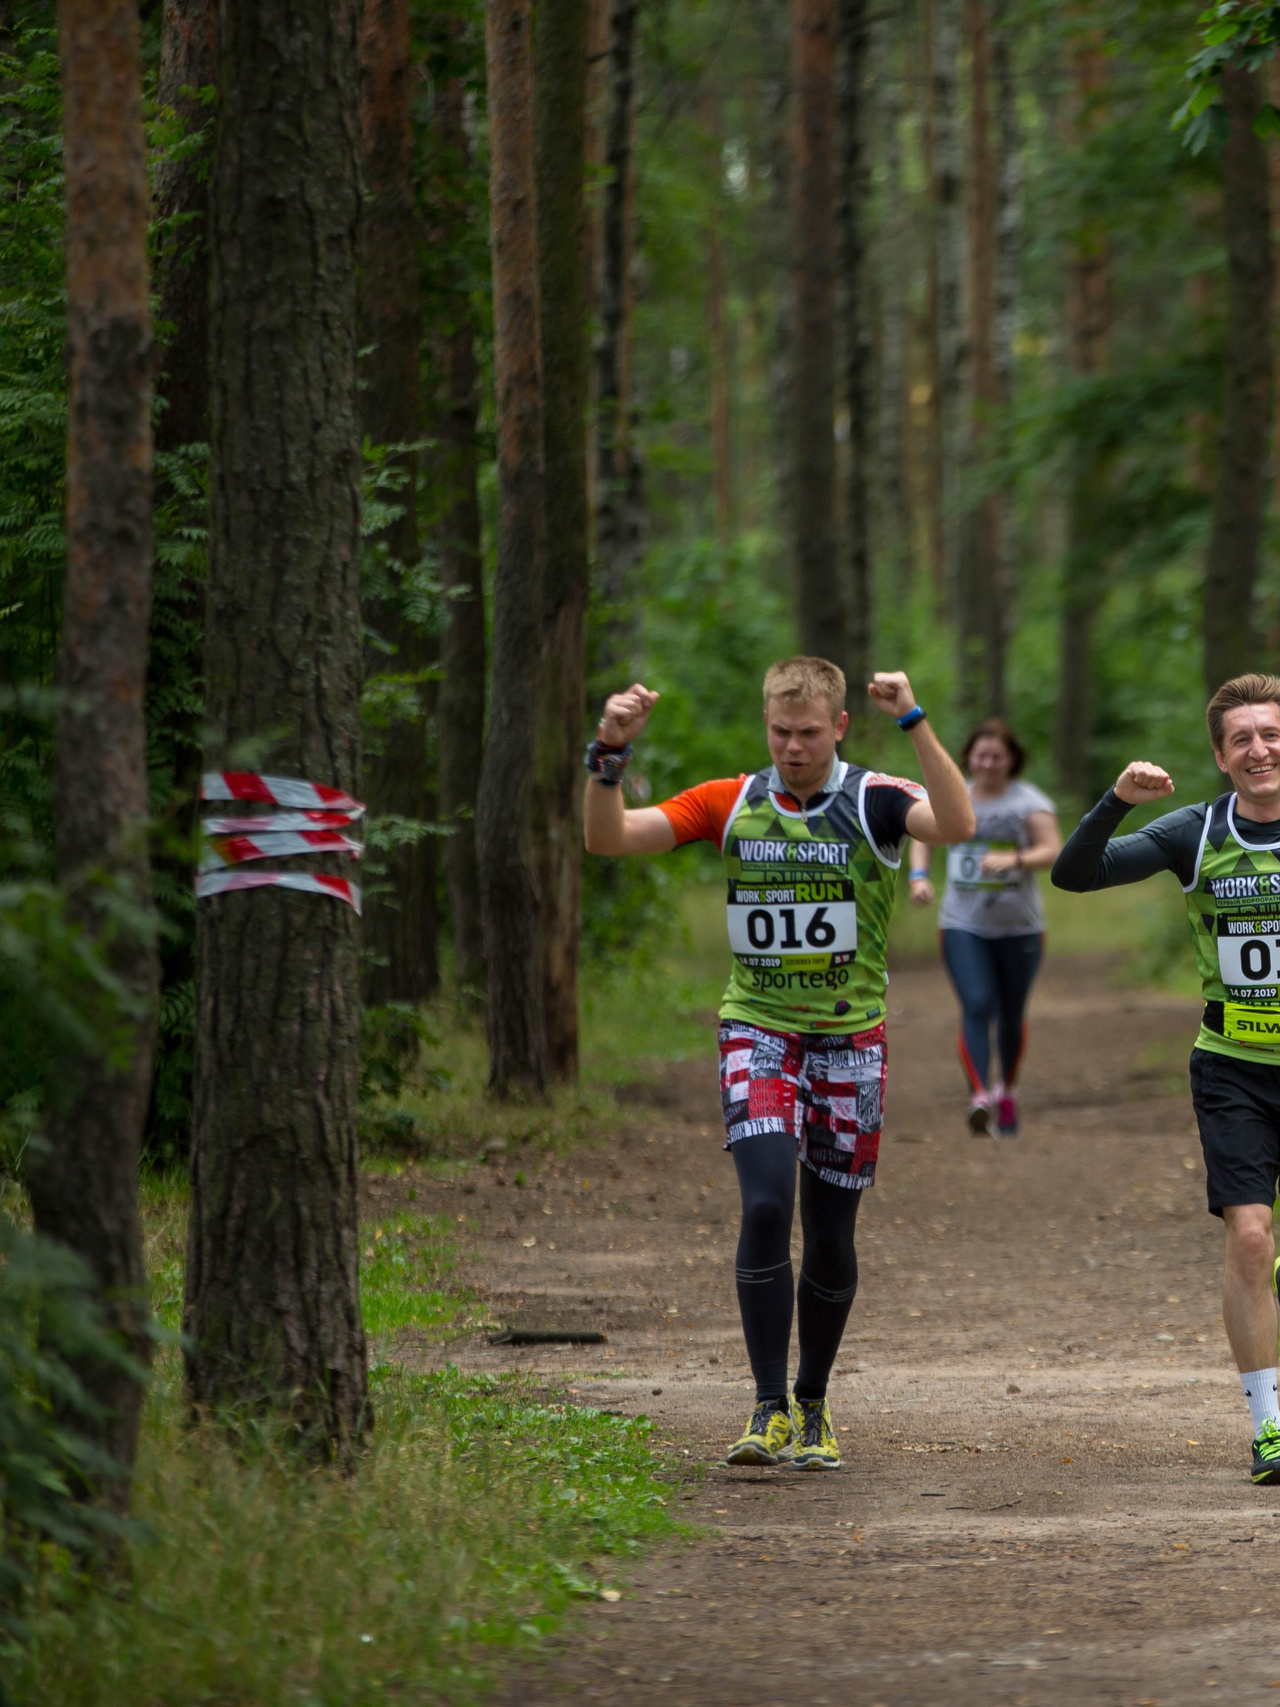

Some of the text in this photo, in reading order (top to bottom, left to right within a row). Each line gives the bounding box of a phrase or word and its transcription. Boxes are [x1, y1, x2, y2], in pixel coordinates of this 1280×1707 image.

[739, 840, 849, 865] WORK&SPORT
[736, 883, 844, 903] WORK&SPORT RUN
[747, 907, 836, 949] 016
[752, 969, 849, 991] sportego
[1230, 988, 1277, 998] 14.07.2019
